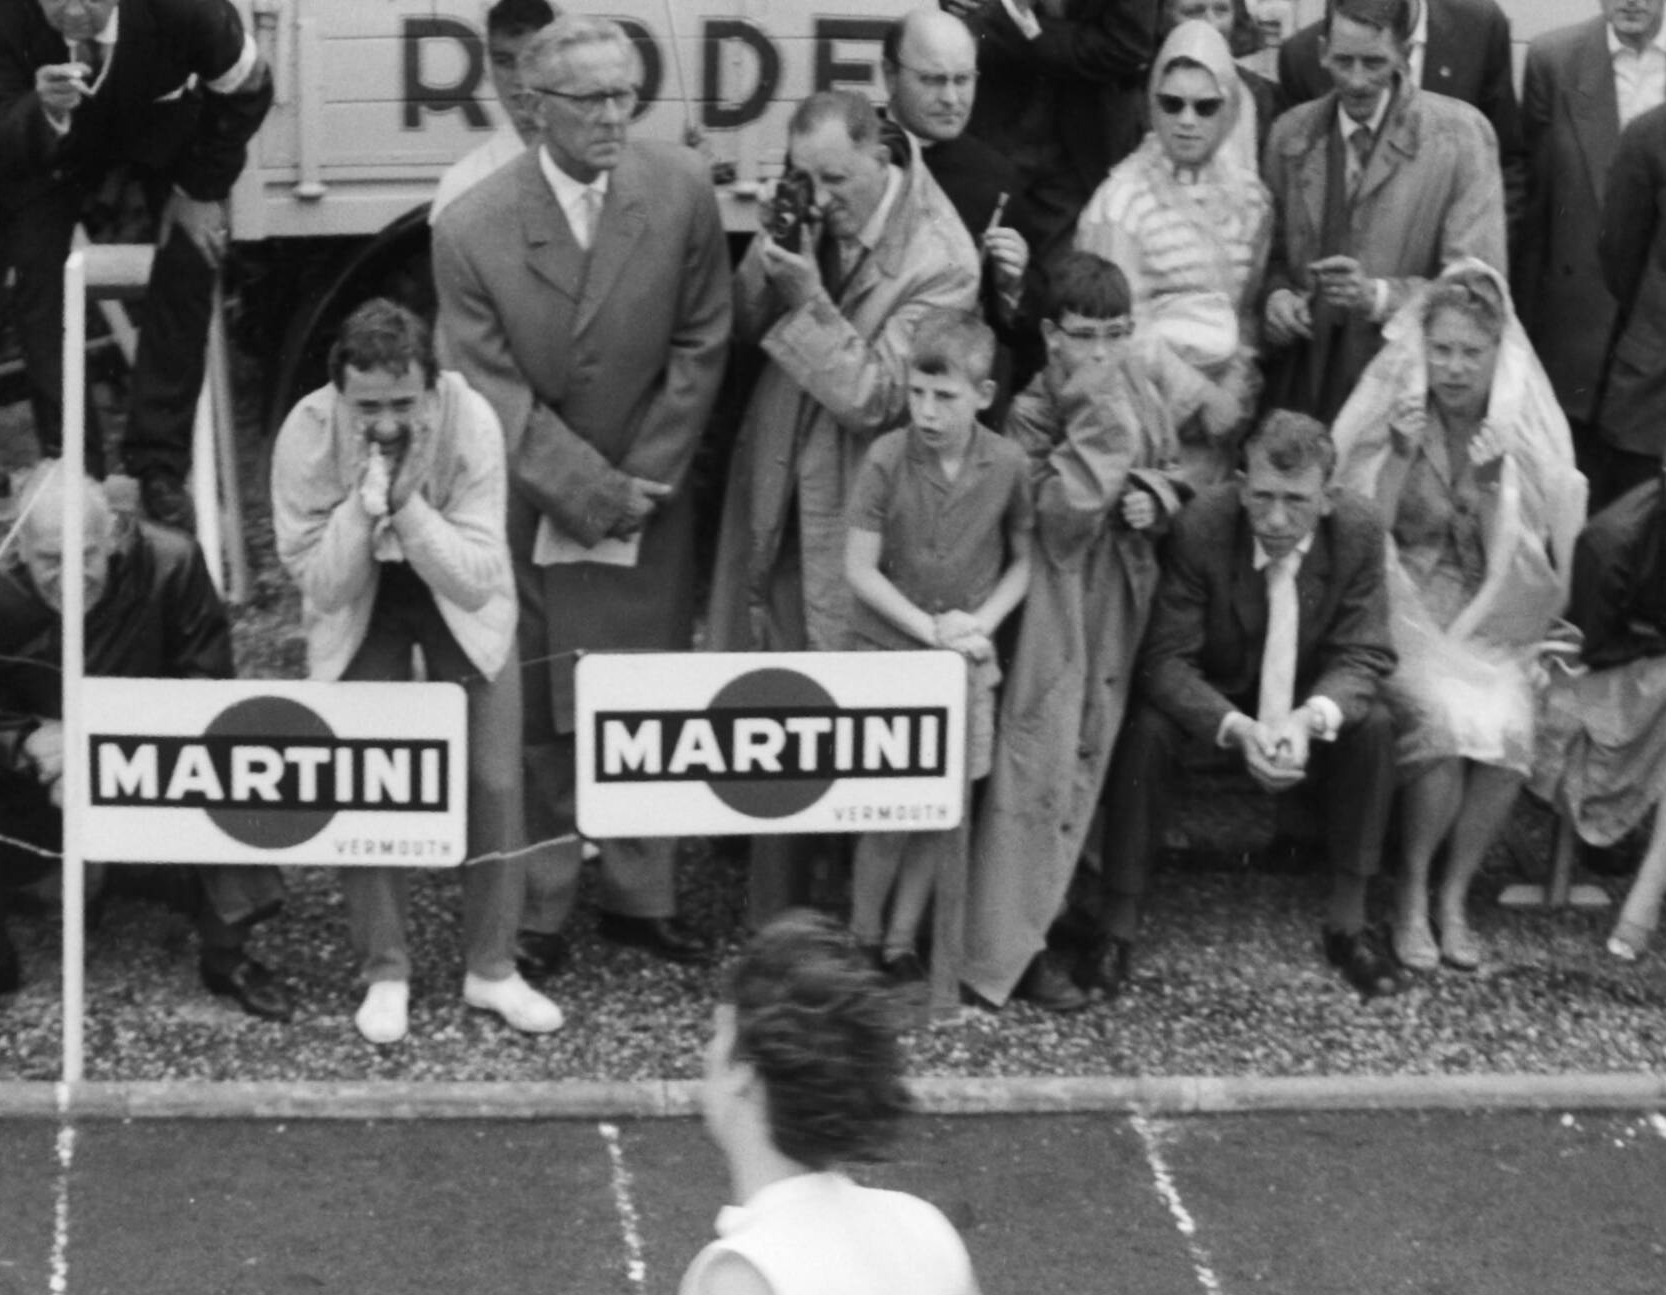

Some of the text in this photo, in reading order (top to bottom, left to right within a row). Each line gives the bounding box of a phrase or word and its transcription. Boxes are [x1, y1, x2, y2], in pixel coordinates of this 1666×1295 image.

[602, 714, 940, 775] MARTINI
[97, 742, 441, 804] MARTINI
[833, 803, 949, 822] VERMOUTH
[334, 838, 453, 856] VERMOUTH
